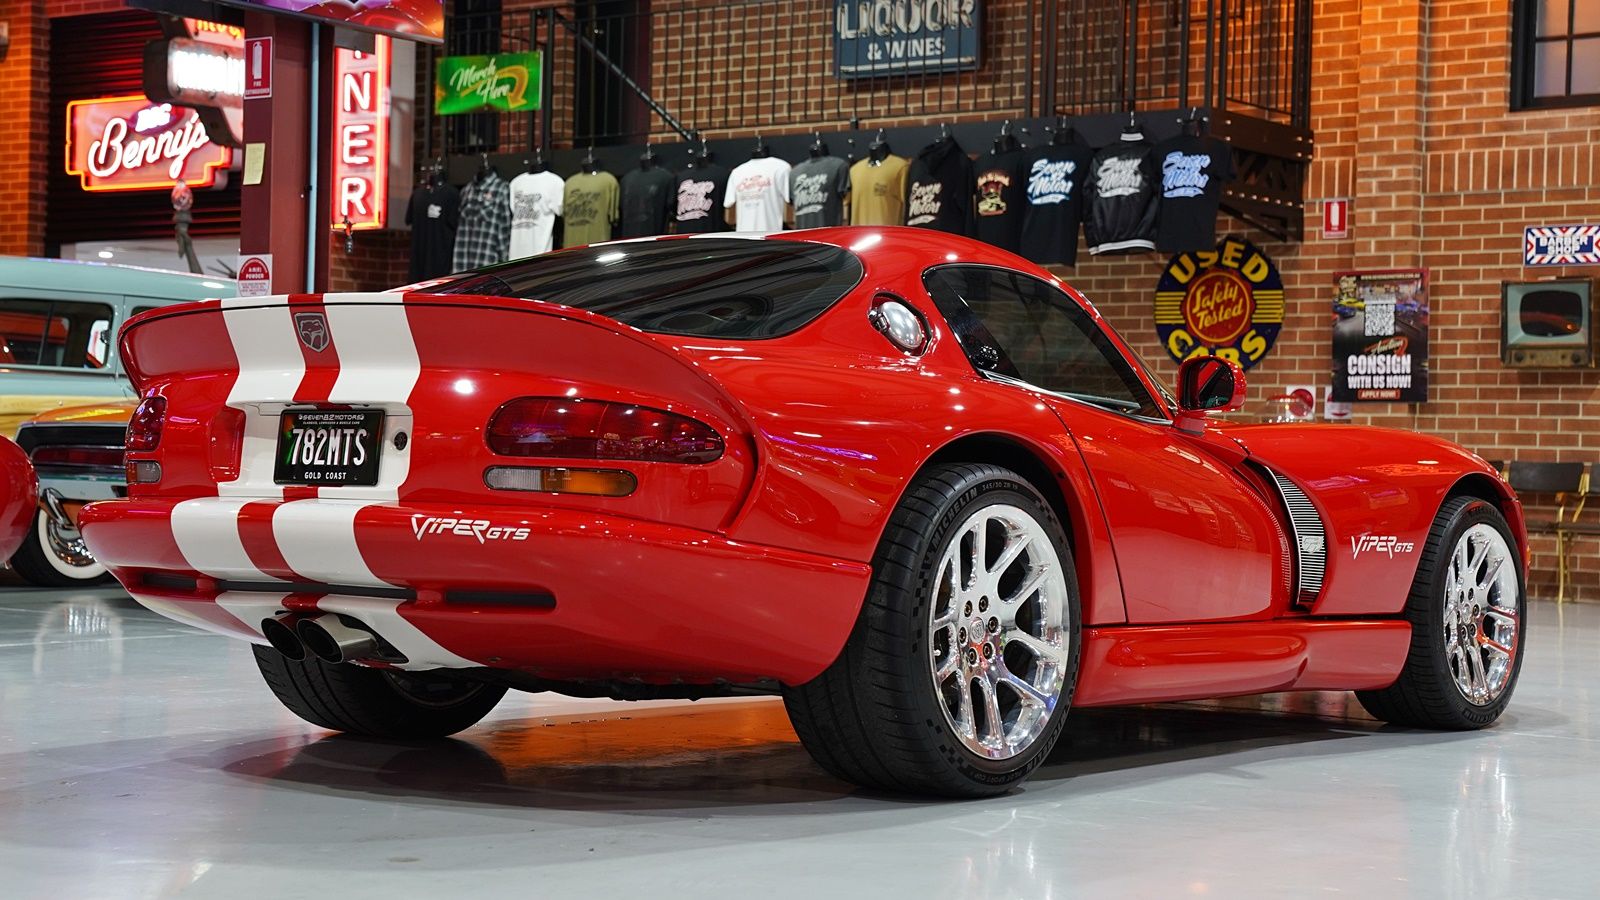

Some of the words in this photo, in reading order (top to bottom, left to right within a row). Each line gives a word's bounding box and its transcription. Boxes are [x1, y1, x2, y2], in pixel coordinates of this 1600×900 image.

[836, 0, 975, 39] LIQUOR
[867, 42, 882, 60] &
[885, 37, 946, 59] WINES
[450, 57, 496, 92] Merch
[476, 74, 510, 104] Here
[87, 113, 209, 180] Benny's
[341, 50, 371, 216] NER
[1540, 235, 1588, 246] BARBER
[1548, 246, 1581, 256] SHOP
[1192, 281, 1238, 314] Safety
[1196, 298, 1243, 330] Tested
[1347, 354, 1412, 375] CONSIGN
[1347, 375, 1372, 389] WITH
[1372, 375, 1386, 388] US
[1386, 375, 1412, 388] NOW!
[1361, 390, 1379, 398] APPLY
[291, 428, 367, 466] 782MTS
[486, 527, 531, 541] GTS
[930, 488, 977, 552] MICHELIN
[1394, 543, 1414, 553] GTS
